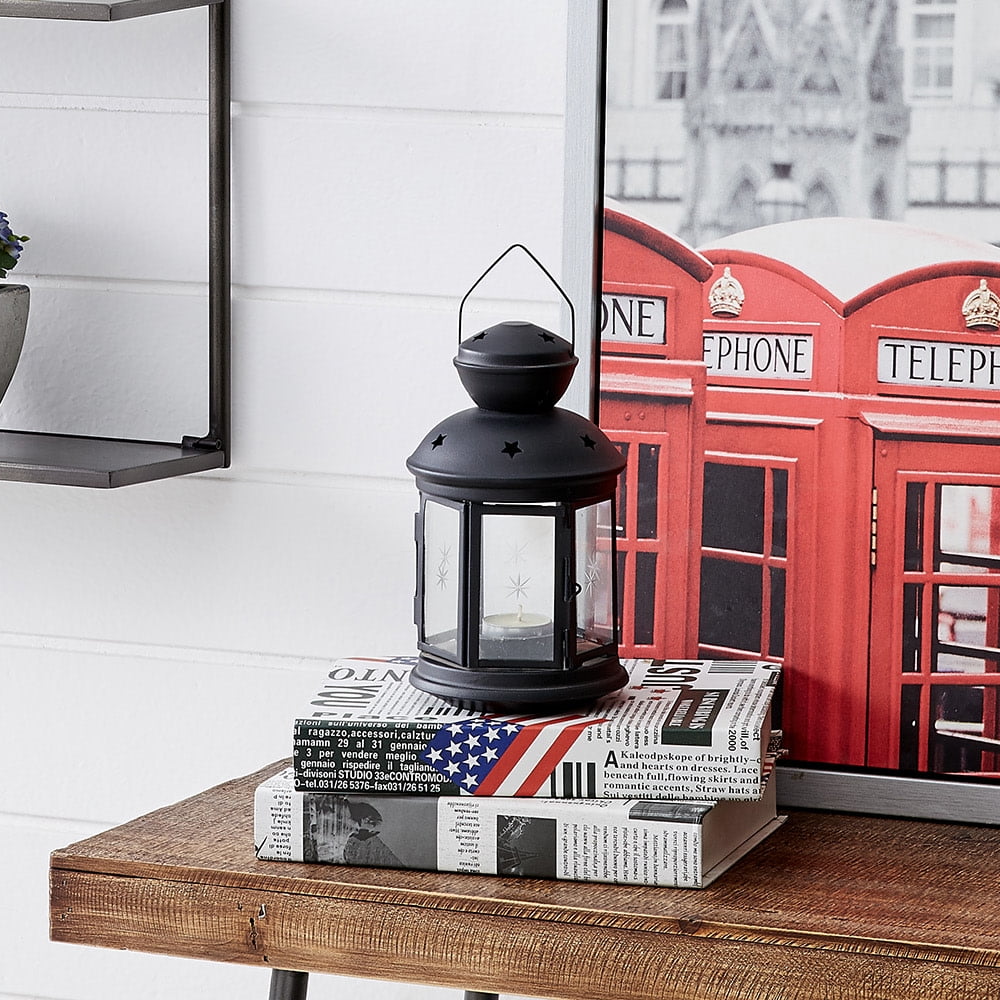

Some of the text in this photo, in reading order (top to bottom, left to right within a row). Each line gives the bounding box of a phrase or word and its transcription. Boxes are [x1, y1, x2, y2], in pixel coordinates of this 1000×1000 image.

[337, 738, 349, 748] 29
[356, 739, 365, 749] al
[371, 739, 382, 749] 31
[390, 741, 427, 751] gennaio
[728, 729, 737, 752] 2000
[306, 748, 312, 757] 3
[319, 750, 334, 759] per
[341, 750, 378, 759] vendere
[385, 751, 417, 762] meglio
[604, 750, 619, 768] A
[300, 759, 336, 769] gennaio
[342, 760, 381, 771] rispedire
[387, 761, 393, 770] il
[641, 762, 674, 771] hearts
[691, 764, 731, 773] dresses.
[734, 765, 758, 774] Lace
[338, 770, 373, 780] STUDIO
[603, 770, 644, 780] beneath
[708, 775, 738, 784] skirts
[740, 776, 759, 784] and
[418, 783, 428, 792] 51
[430, 784, 441, 792] 25
[603, 782, 650, 790] romantic
[652, 785, 693, 793] accents,
[695, 784, 726, 793] Straw
[728, 786, 750, 794] hats
